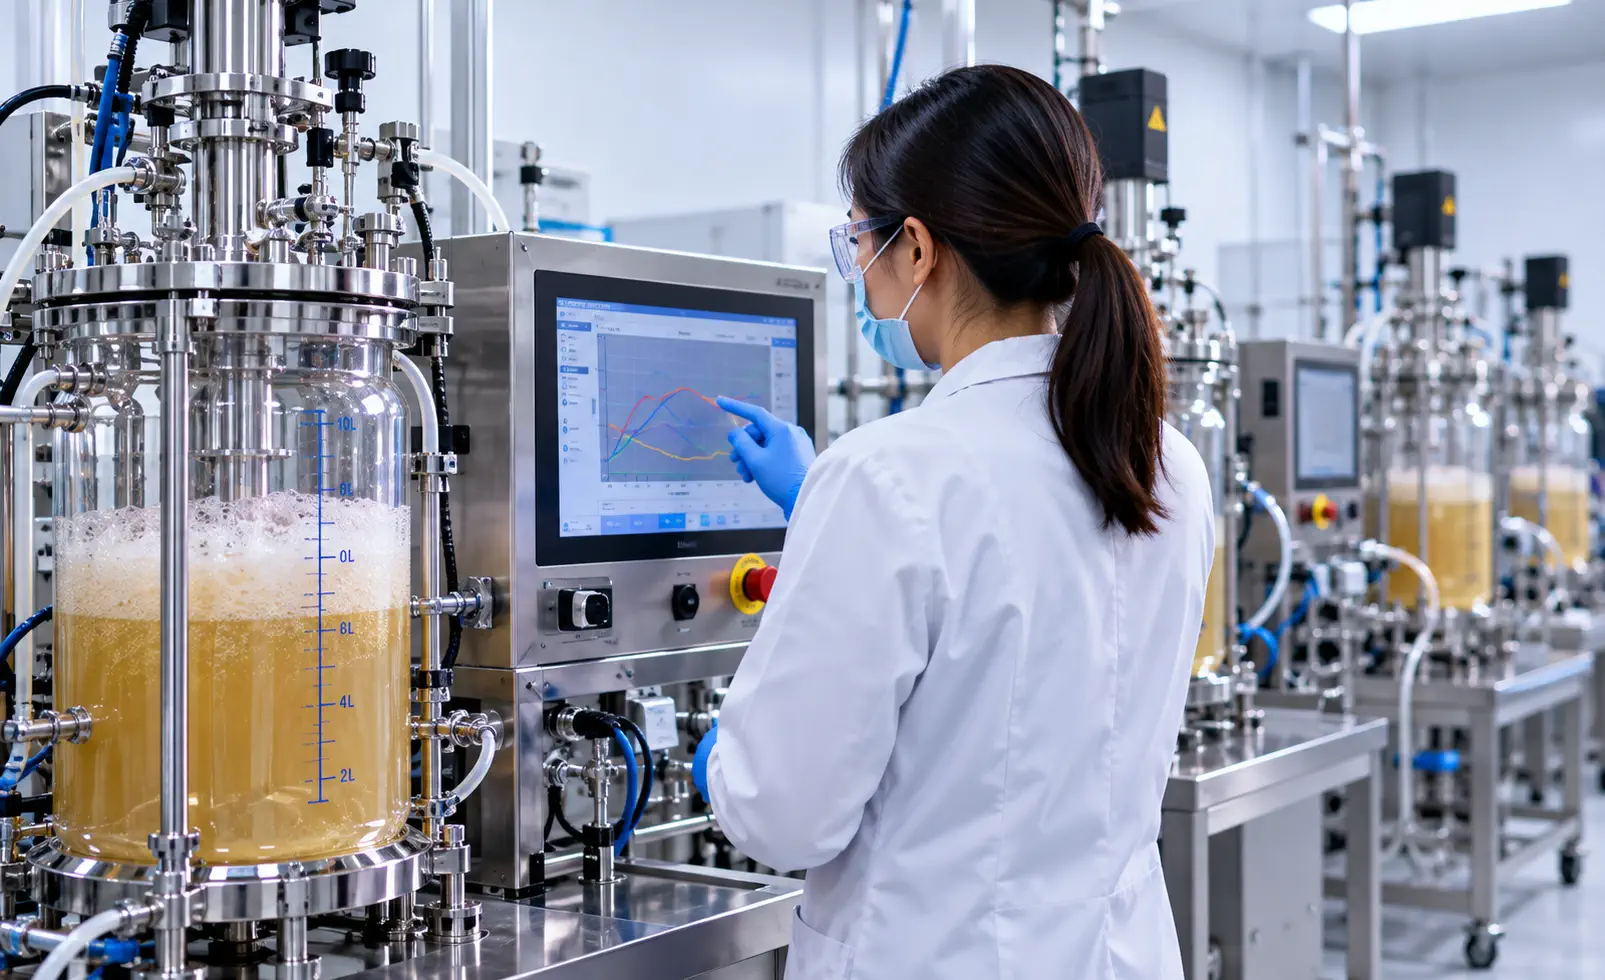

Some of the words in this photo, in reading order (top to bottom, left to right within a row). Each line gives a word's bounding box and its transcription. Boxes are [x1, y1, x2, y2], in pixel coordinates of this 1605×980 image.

[337, 415, 356, 431] 10L
[340, 549, 355, 563] 0L
[340, 694, 355, 709] 4L
[340, 768, 356, 782] 2L
